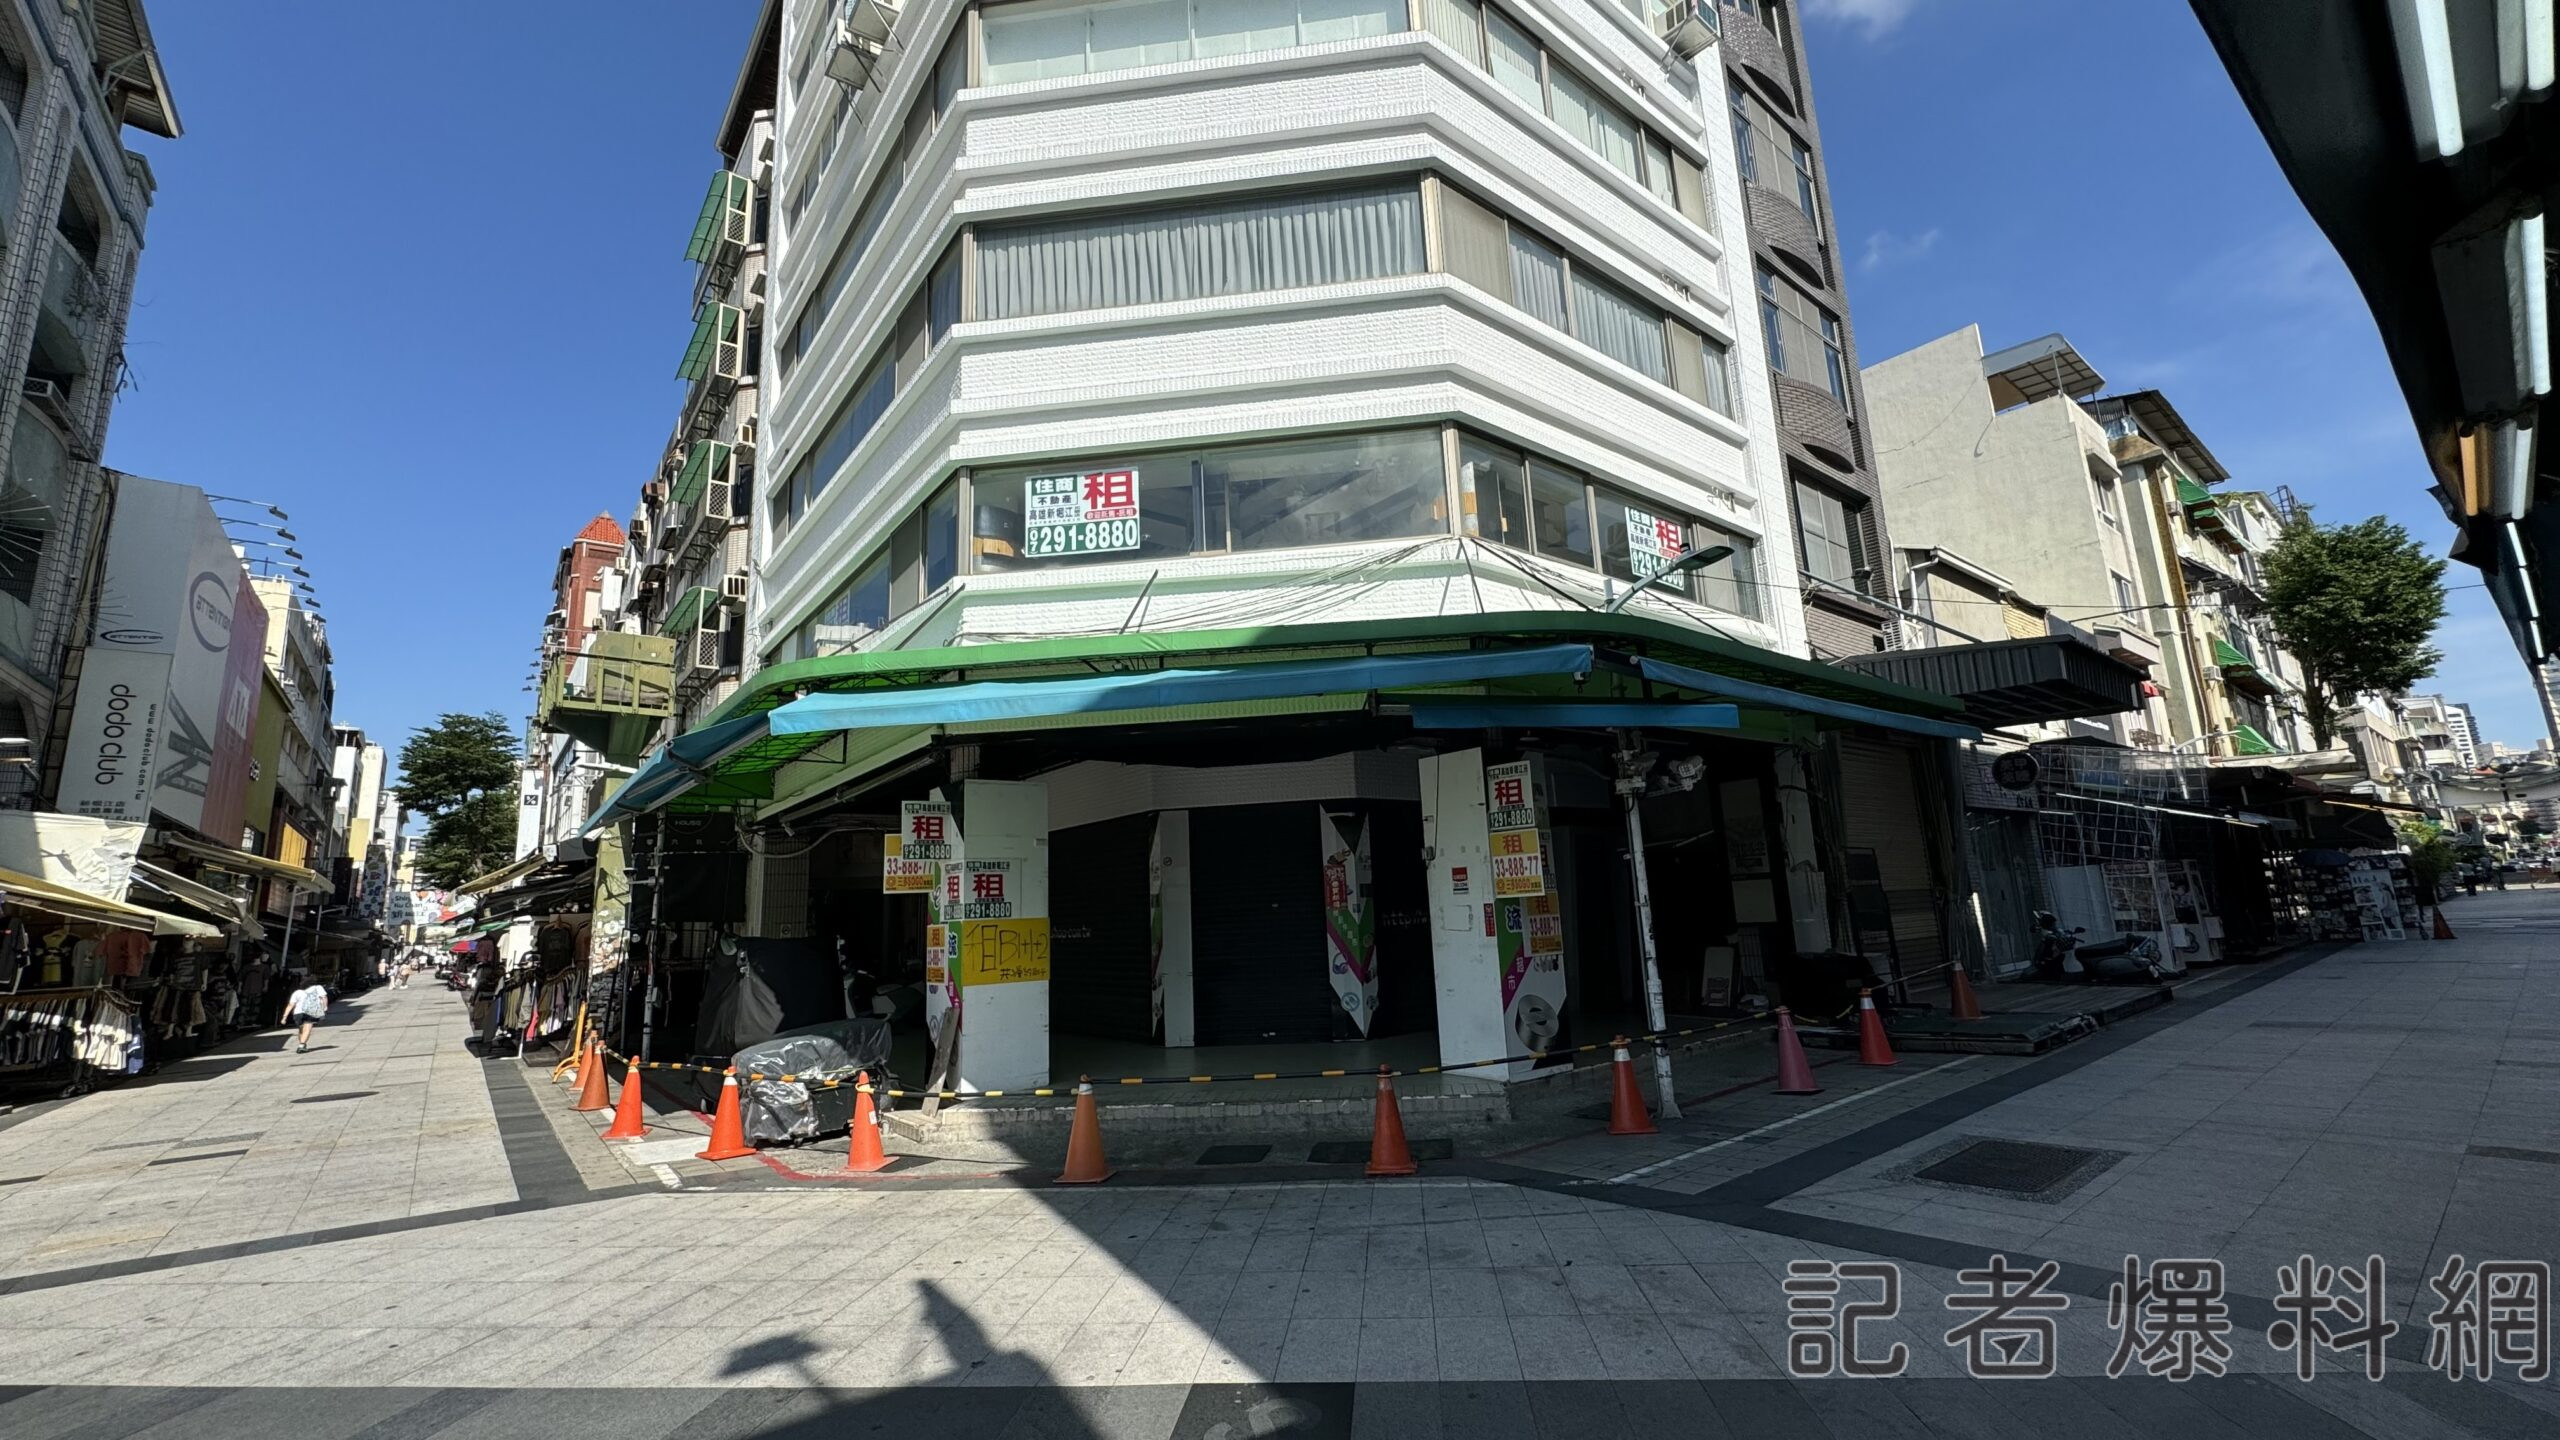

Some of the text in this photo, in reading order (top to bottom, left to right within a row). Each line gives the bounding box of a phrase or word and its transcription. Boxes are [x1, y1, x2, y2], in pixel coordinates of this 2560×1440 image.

[1035, 477, 1074, 494] 住商
[1083, 471, 1135, 509] 租
[1037, 494, 1072, 505] 不動產
[1040, 519, 1137, 553] 291-8880
[1655, 517, 1682, 554] 租
[1494, 778, 1524, 806] 租
[911, 815, 944, 840] 租
[1495, 809, 1532, 826] 291-8880
[909, 844, 951, 859] 291-8880
[1503, 834, 1523, 853] 租
[1495, 855, 1539, 878] 33-888-77
[947, 875, 960, 899] 租
[972, 873, 1004, 898] 租
[970, 902, 1011, 918] 291-8880
